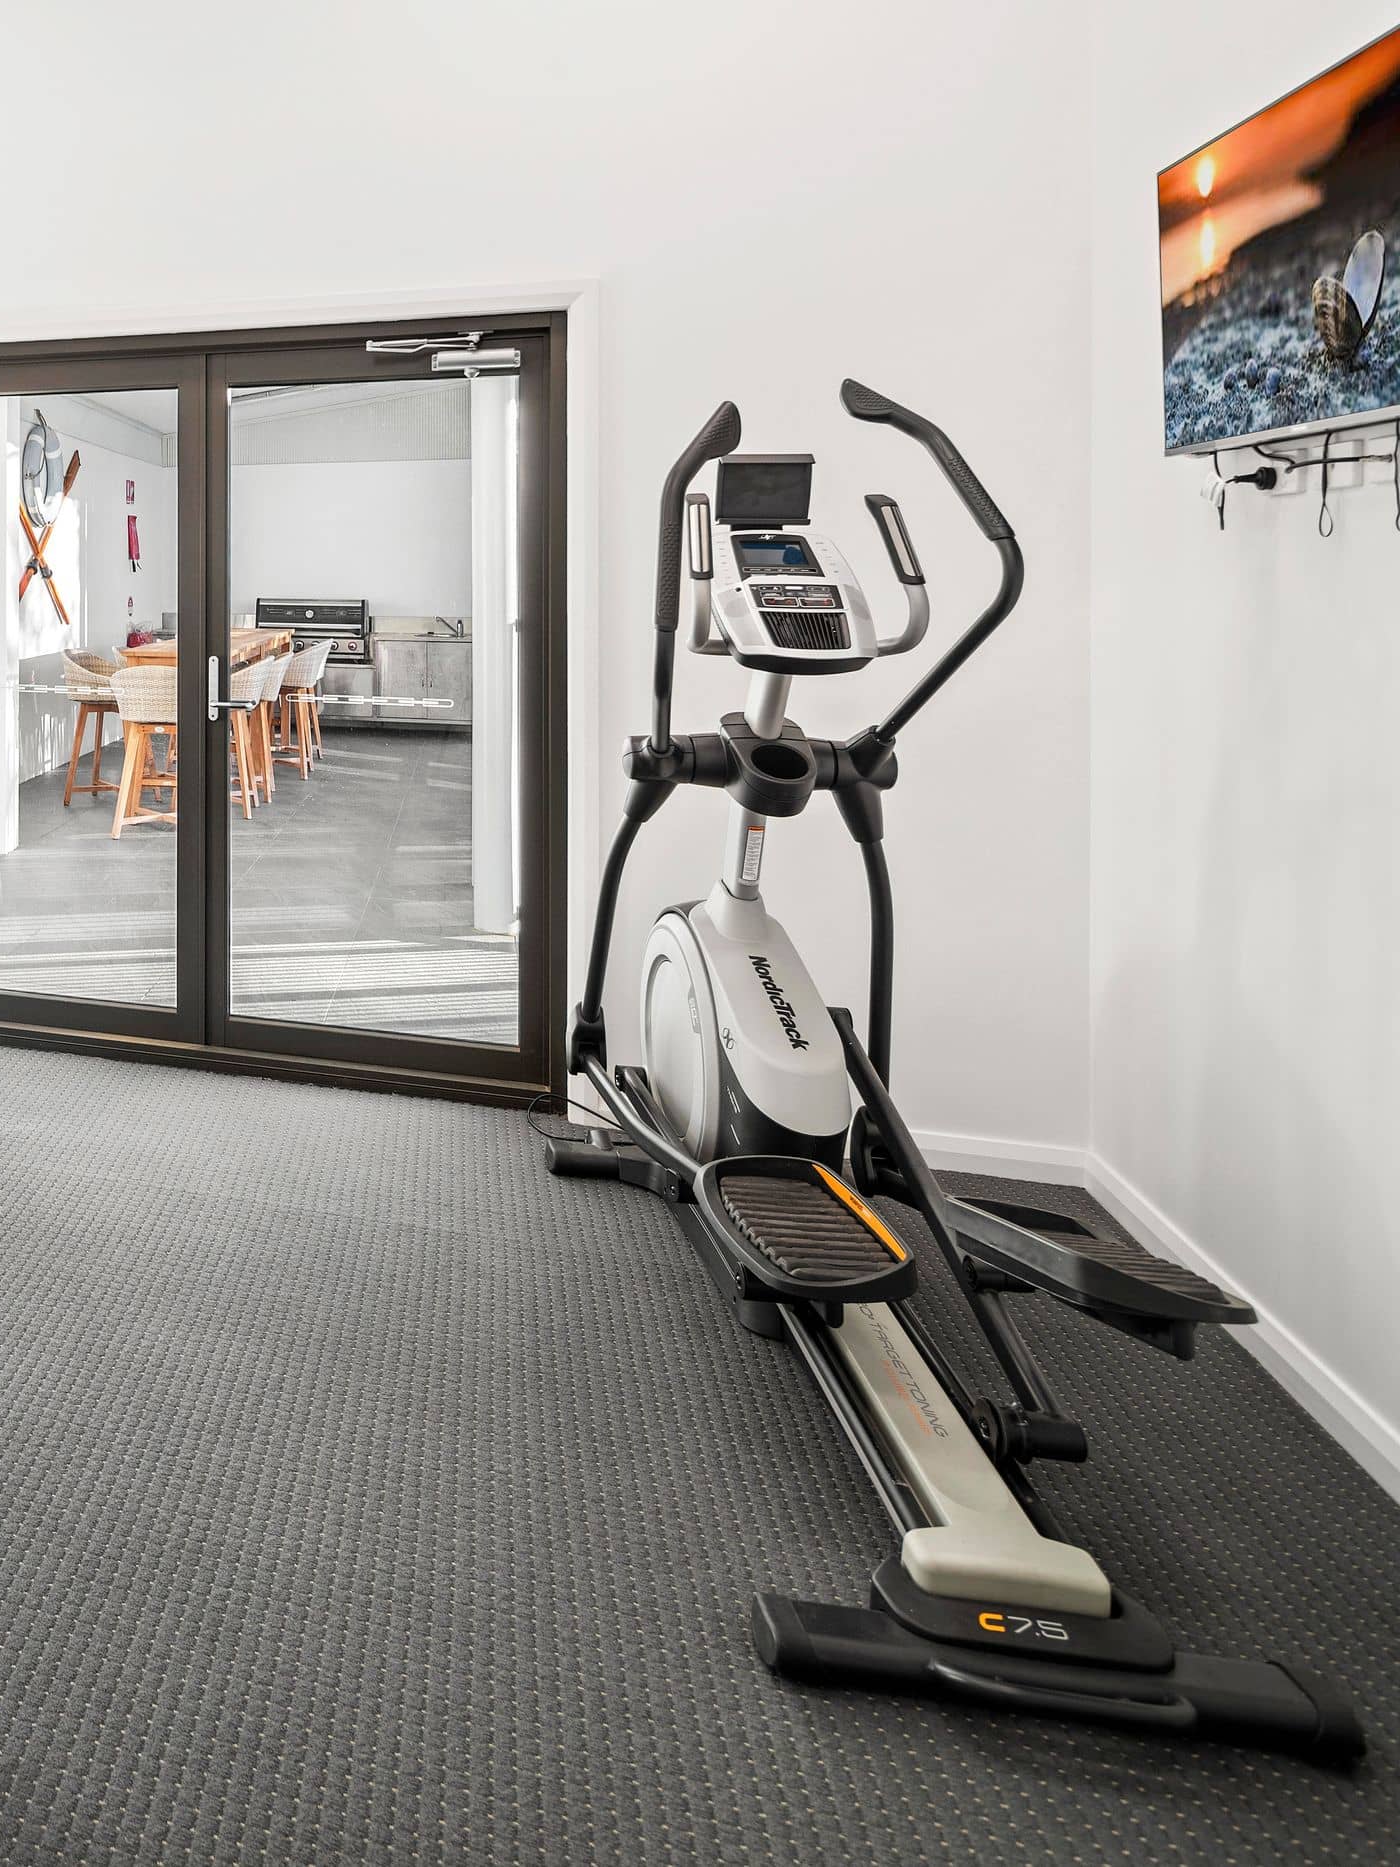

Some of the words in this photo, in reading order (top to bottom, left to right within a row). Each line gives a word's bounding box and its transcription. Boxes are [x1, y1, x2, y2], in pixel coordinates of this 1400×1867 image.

[748, 955, 810, 1051] NordicTrack
[870, 1322, 914, 1380] TARGET
[906, 1380, 949, 1438] TONING
[979, 1612, 1069, 1640] C7.5
